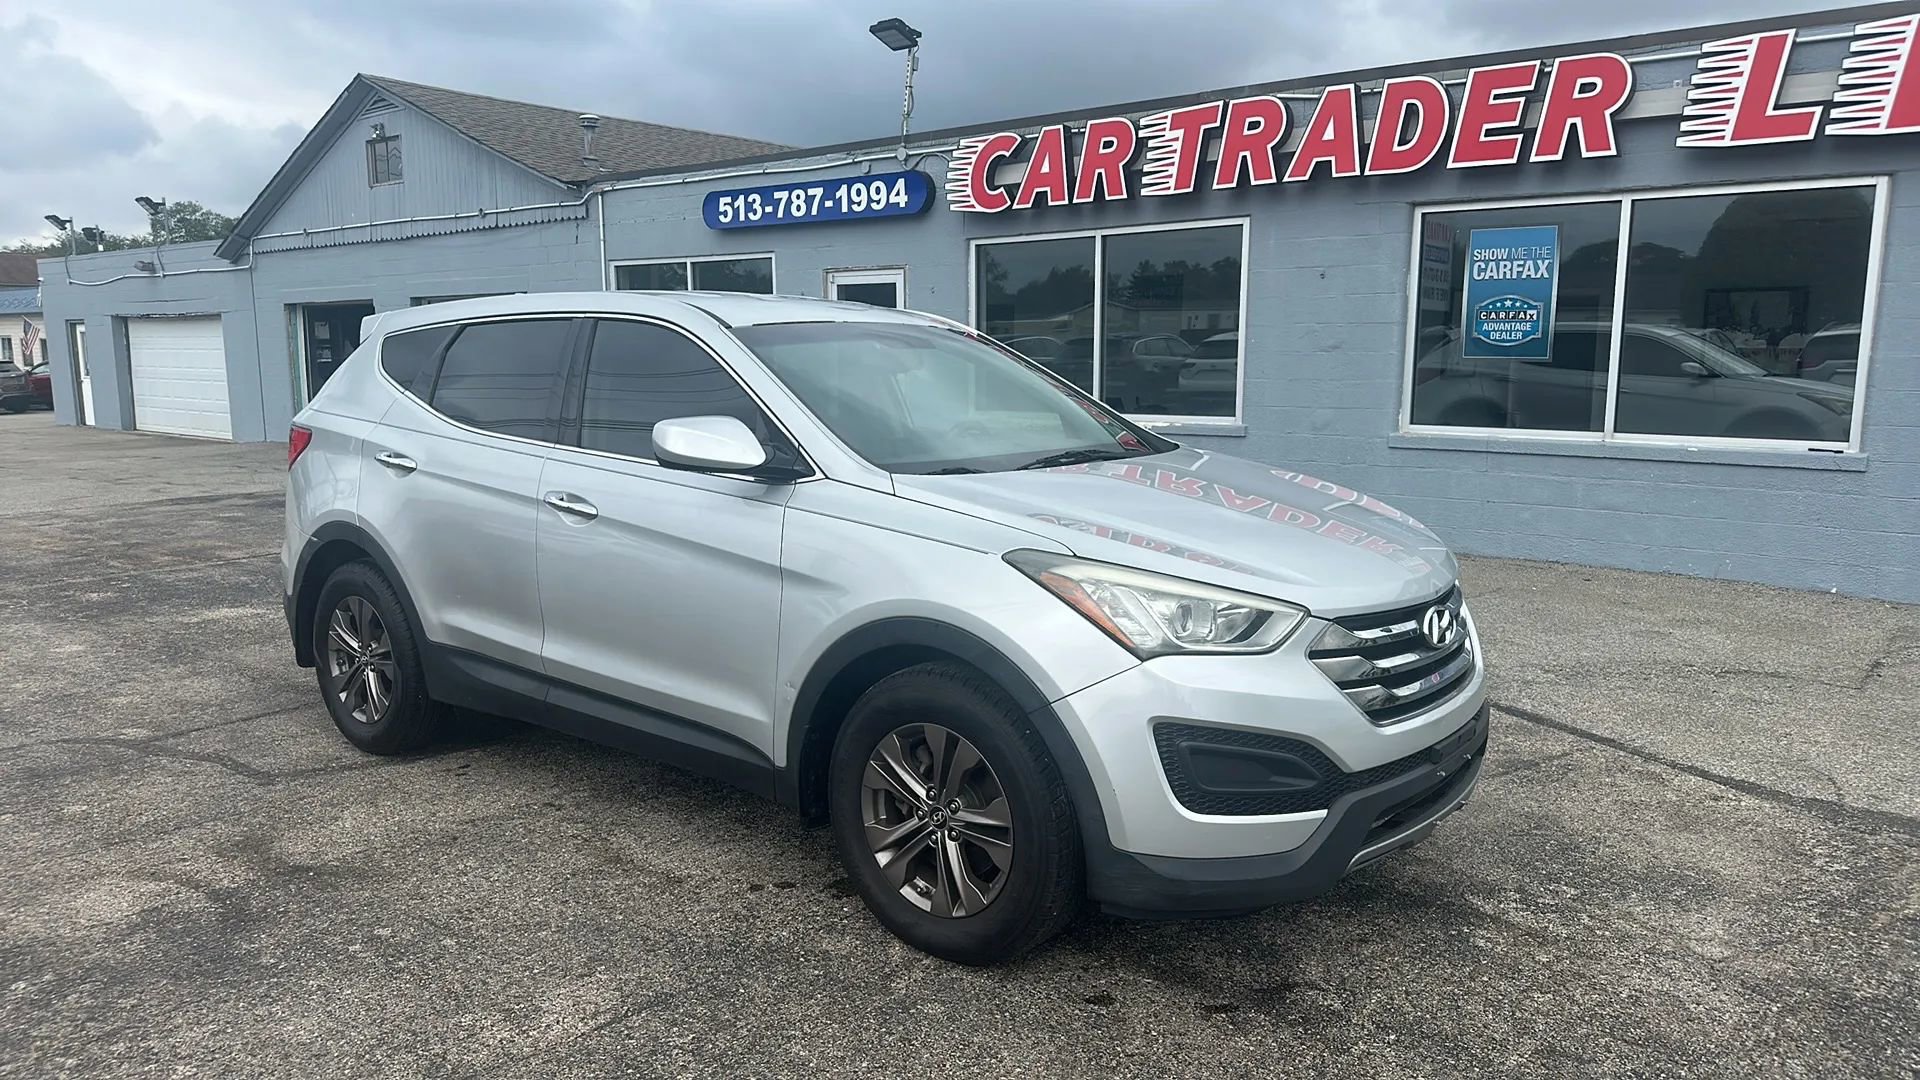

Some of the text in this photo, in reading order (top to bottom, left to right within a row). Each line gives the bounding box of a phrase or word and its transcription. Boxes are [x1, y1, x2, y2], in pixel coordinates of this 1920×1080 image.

[945, 115, 1137, 213] CAR
[1139, 52, 1634, 197] TRADER
[718, 178, 908, 223] 513-787-1994
[1473, 246, 1552, 261] SHOW ME THE
[1472, 260, 1552, 280] CARFAX
[1480, 310, 1537, 320] CARFAX
[1482, 322, 1532, 331] ADVANTAGE
[1490, 331, 1523, 340] DEALER
